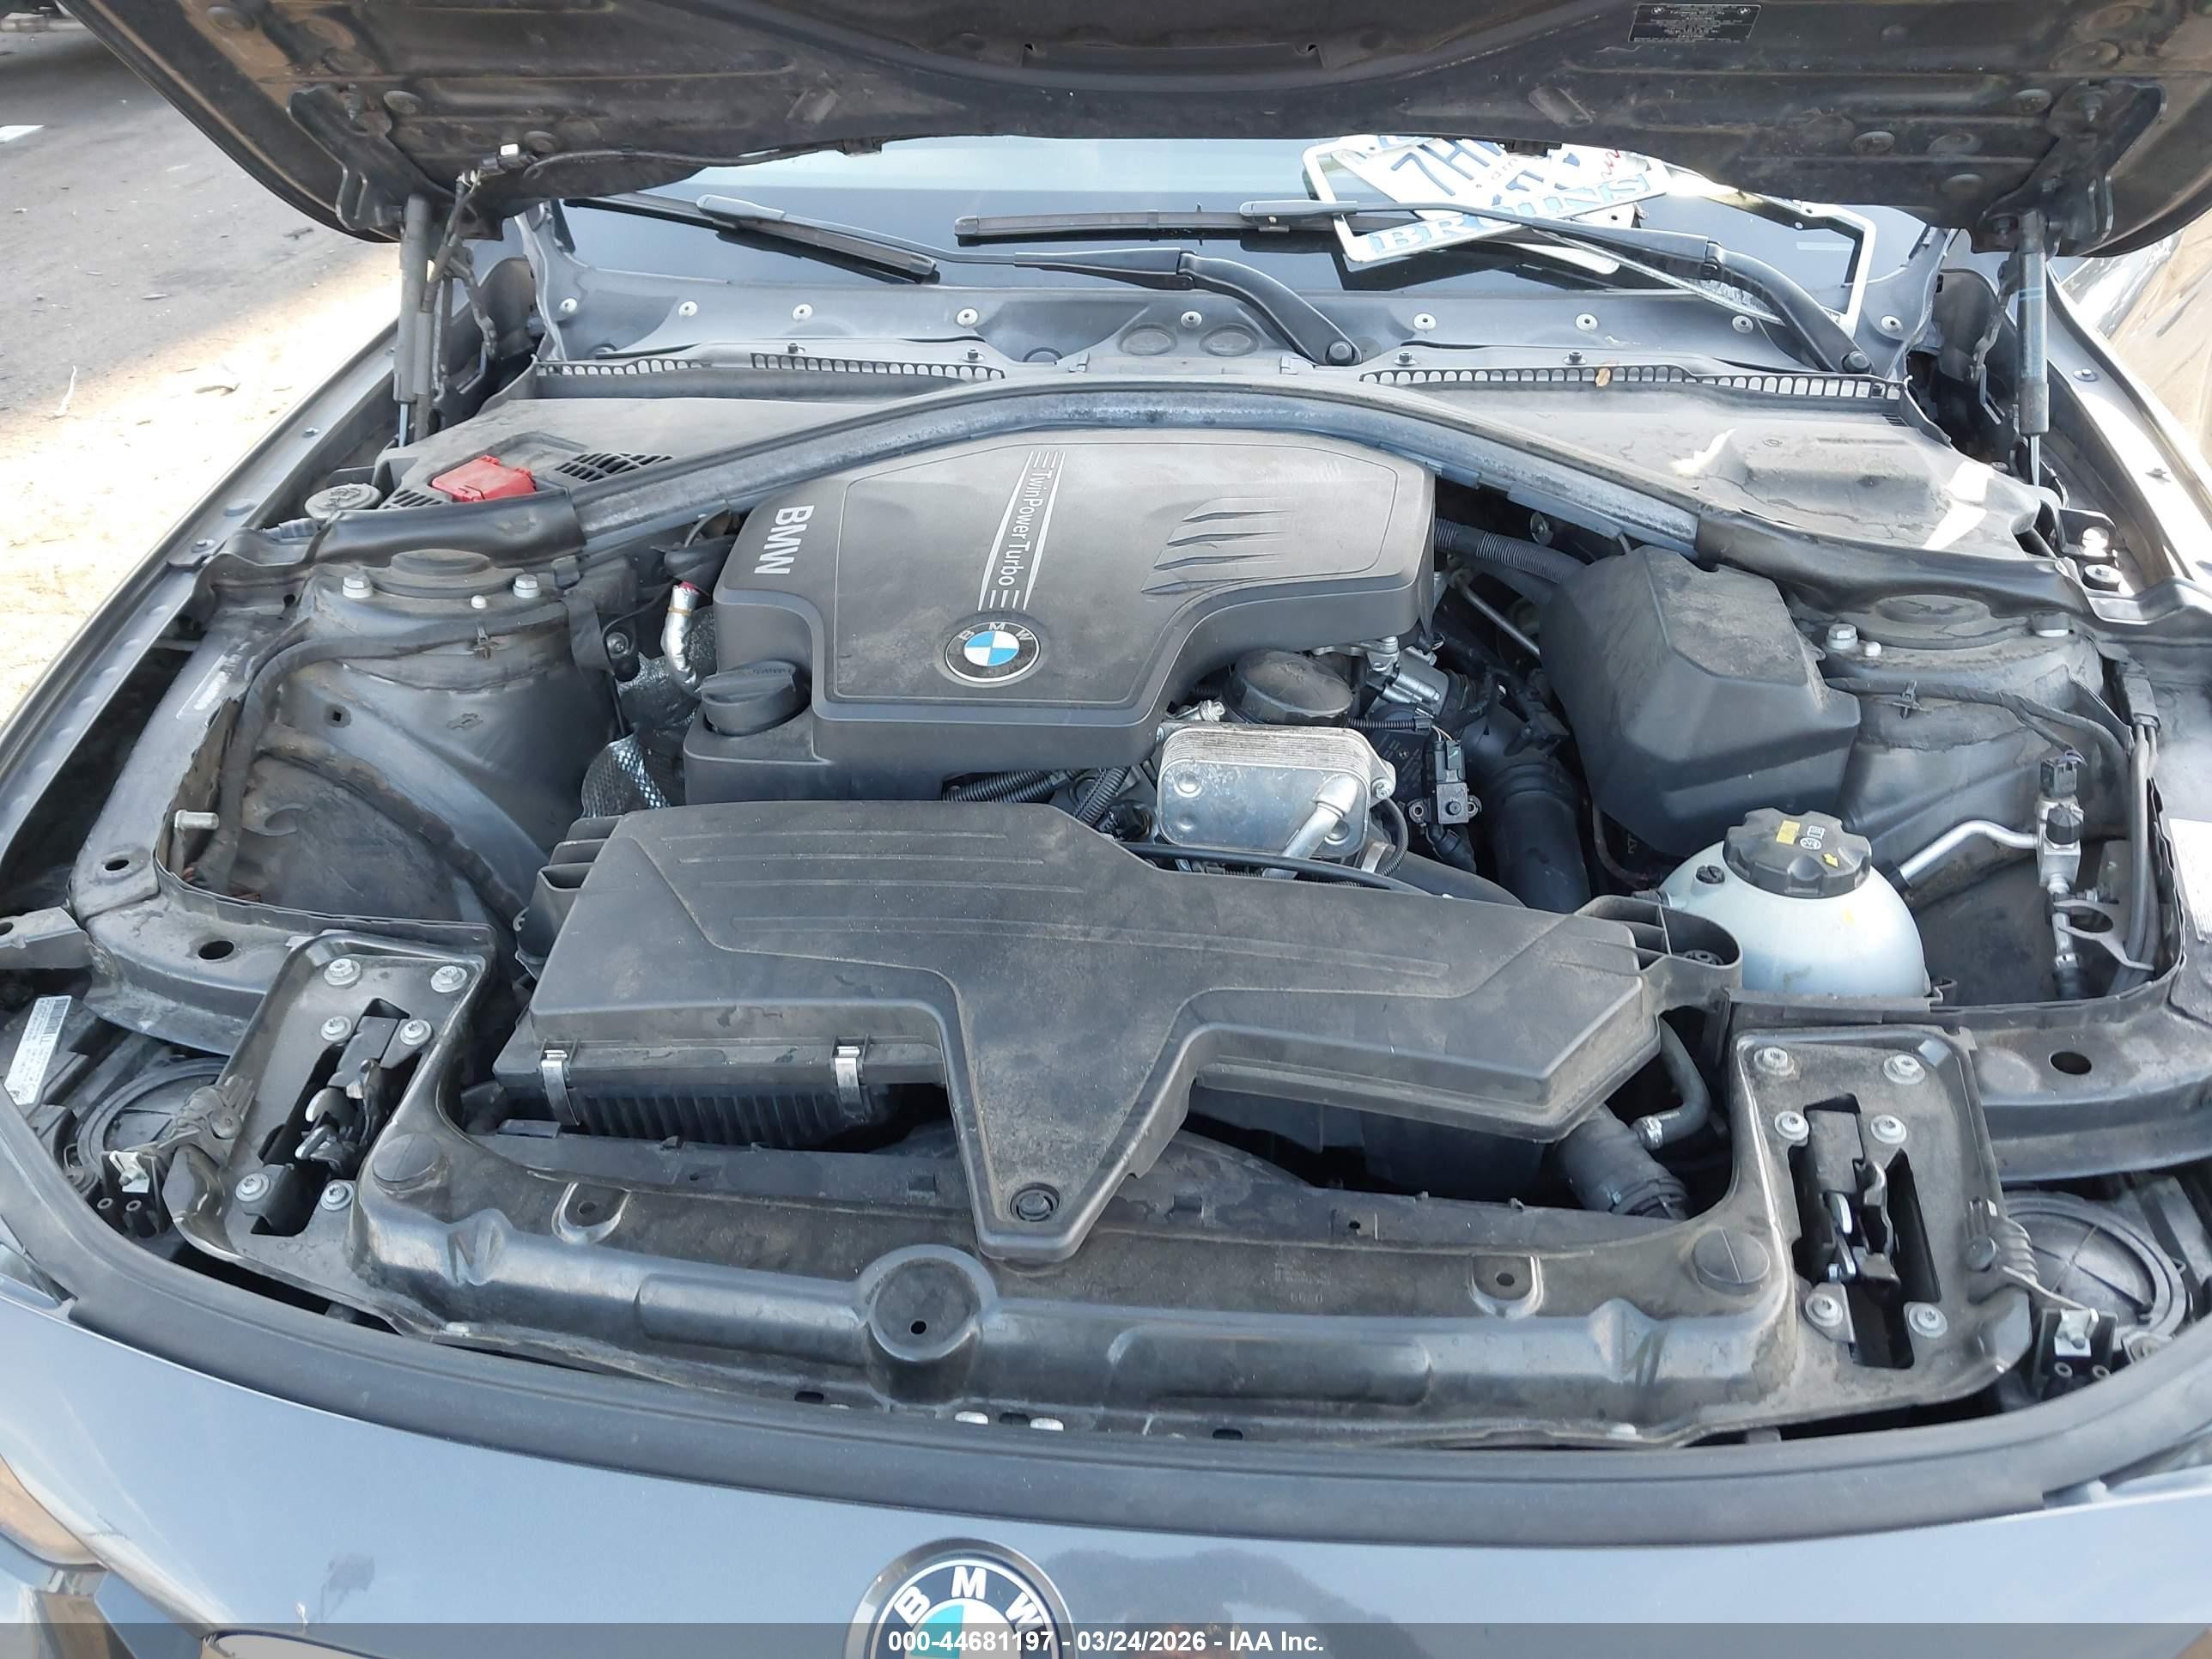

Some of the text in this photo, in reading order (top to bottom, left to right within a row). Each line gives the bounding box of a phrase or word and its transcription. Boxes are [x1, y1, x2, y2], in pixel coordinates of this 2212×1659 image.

[755, 505, 814, 574] BMW
[998, 470, 1052, 586] TwinPower Turbo
[958, 622, 1034, 641] BMW
[894, 1565, 1045, 1634] BMW
